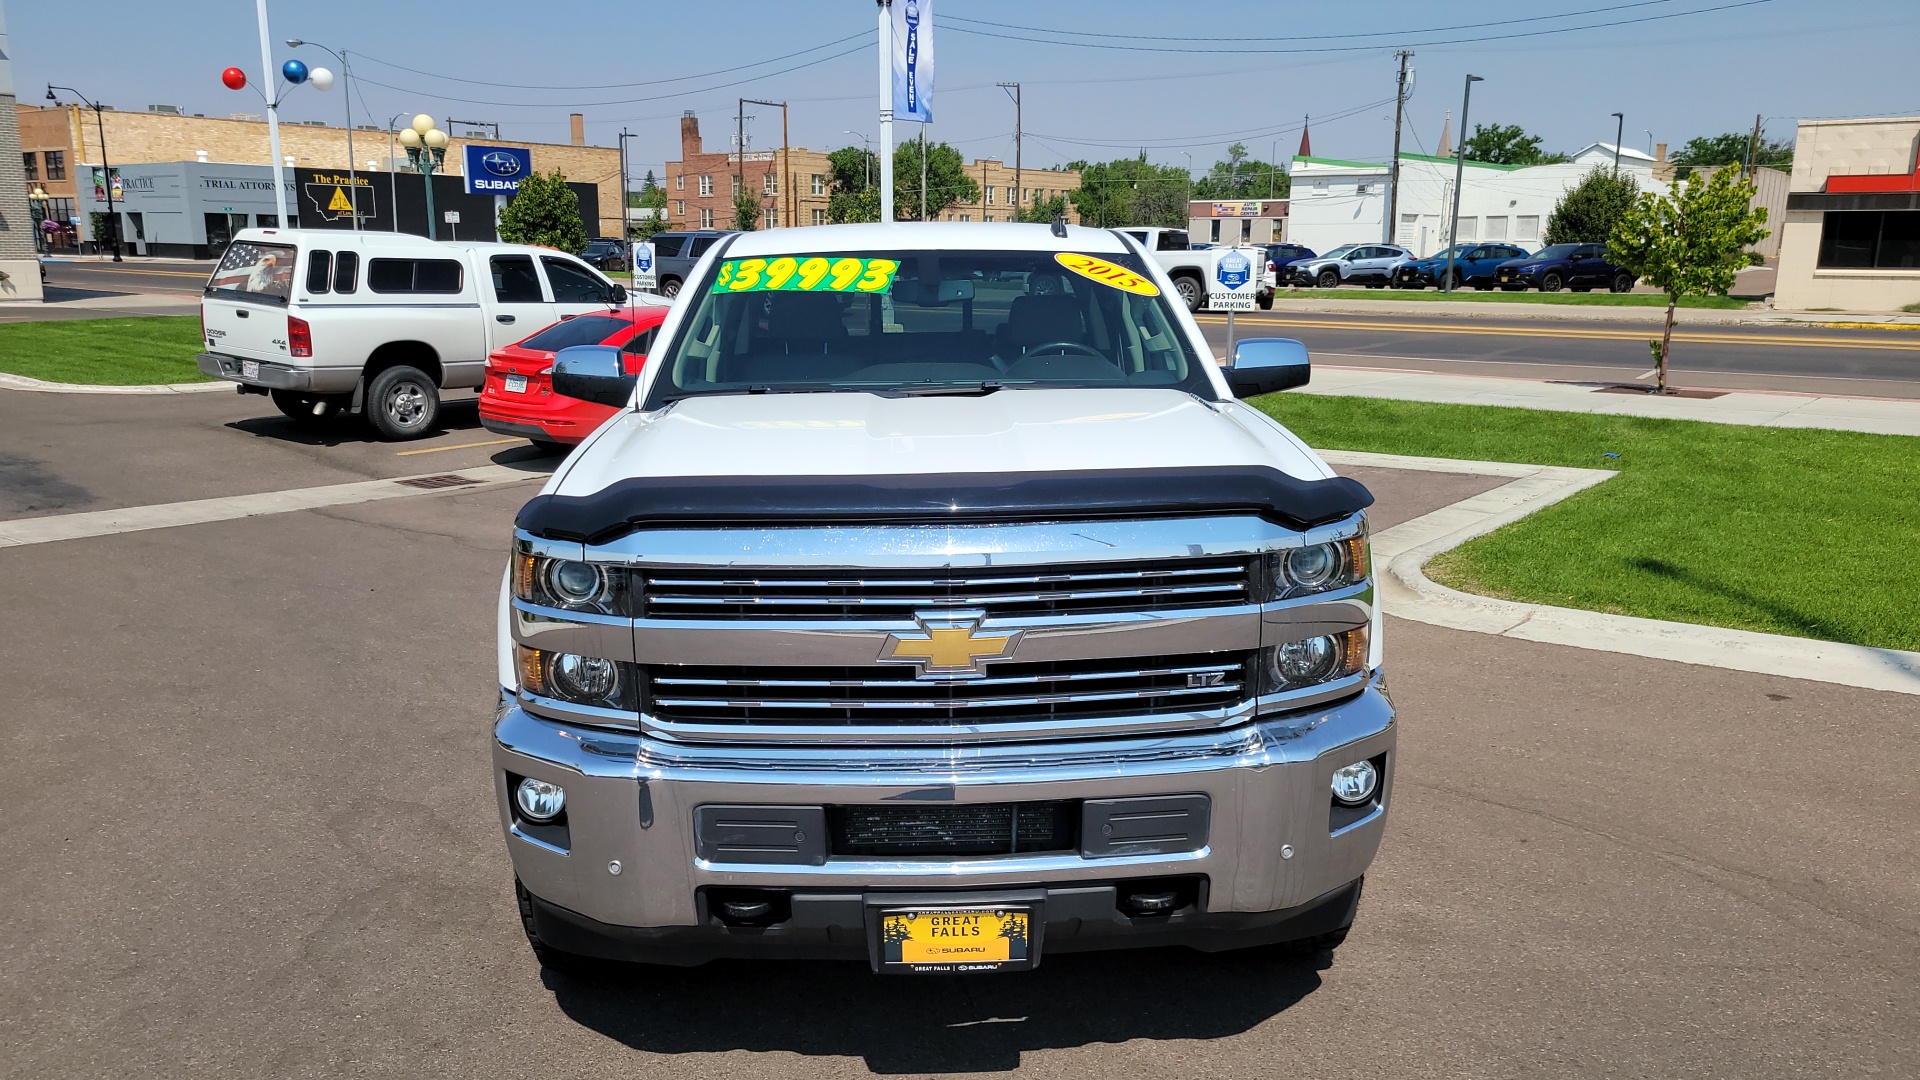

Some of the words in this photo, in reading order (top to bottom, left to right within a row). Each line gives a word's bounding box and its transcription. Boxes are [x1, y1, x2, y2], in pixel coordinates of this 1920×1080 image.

[313, 174, 332, 184] The
[474, 179, 520, 190] SUBAR
[204, 180, 237, 189] TRIAL
[239, 180, 296, 192] ATTORNYS
[718, 257, 897, 291] $39993
[1069, 259, 1145, 287] 2015
[1209, 292, 1256, 300] CUSTOMER
[1213, 301, 1251, 309] PARKING
[1187, 672, 1226, 688] LTZ
[932, 916, 980, 926] GREAT
[932, 926, 980, 937] FALLS
